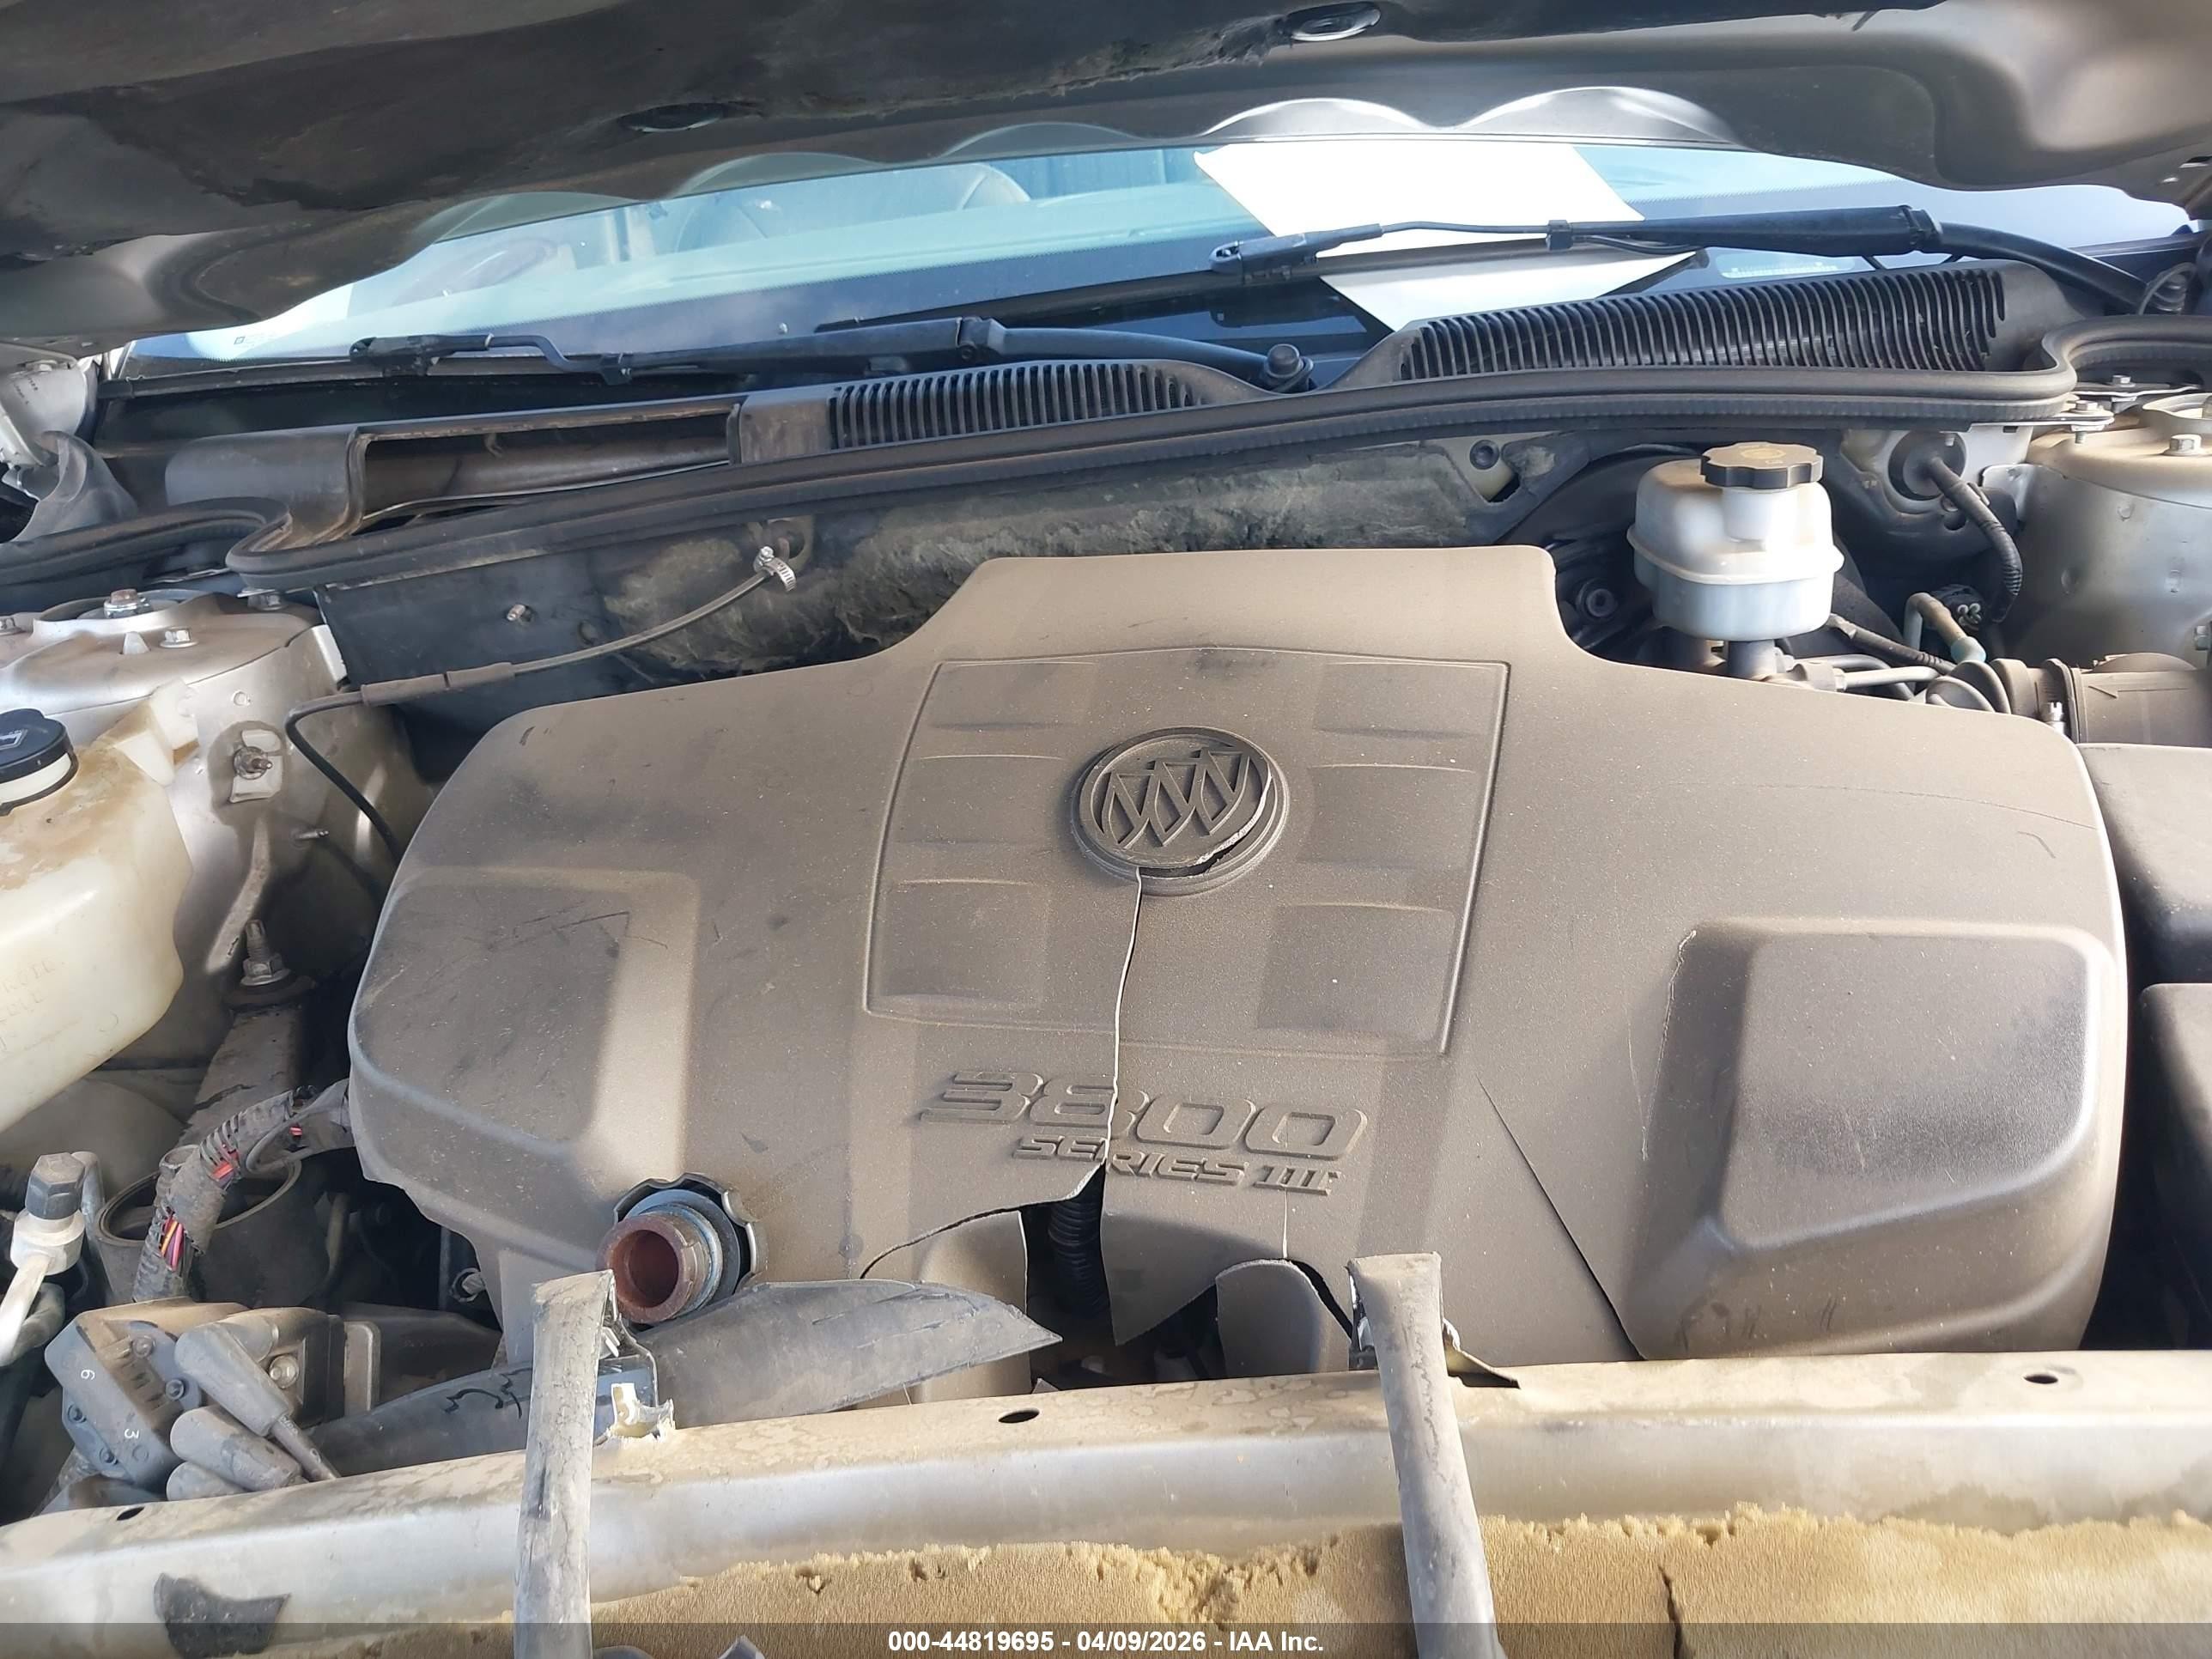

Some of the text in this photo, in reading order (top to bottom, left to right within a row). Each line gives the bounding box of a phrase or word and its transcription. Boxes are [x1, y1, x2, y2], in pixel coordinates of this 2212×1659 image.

[917, 1071, 1368, 1161] 3800
[1012, 1133, 1341, 1196] SERIES III
[124, 1428, 140, 1439] 3
